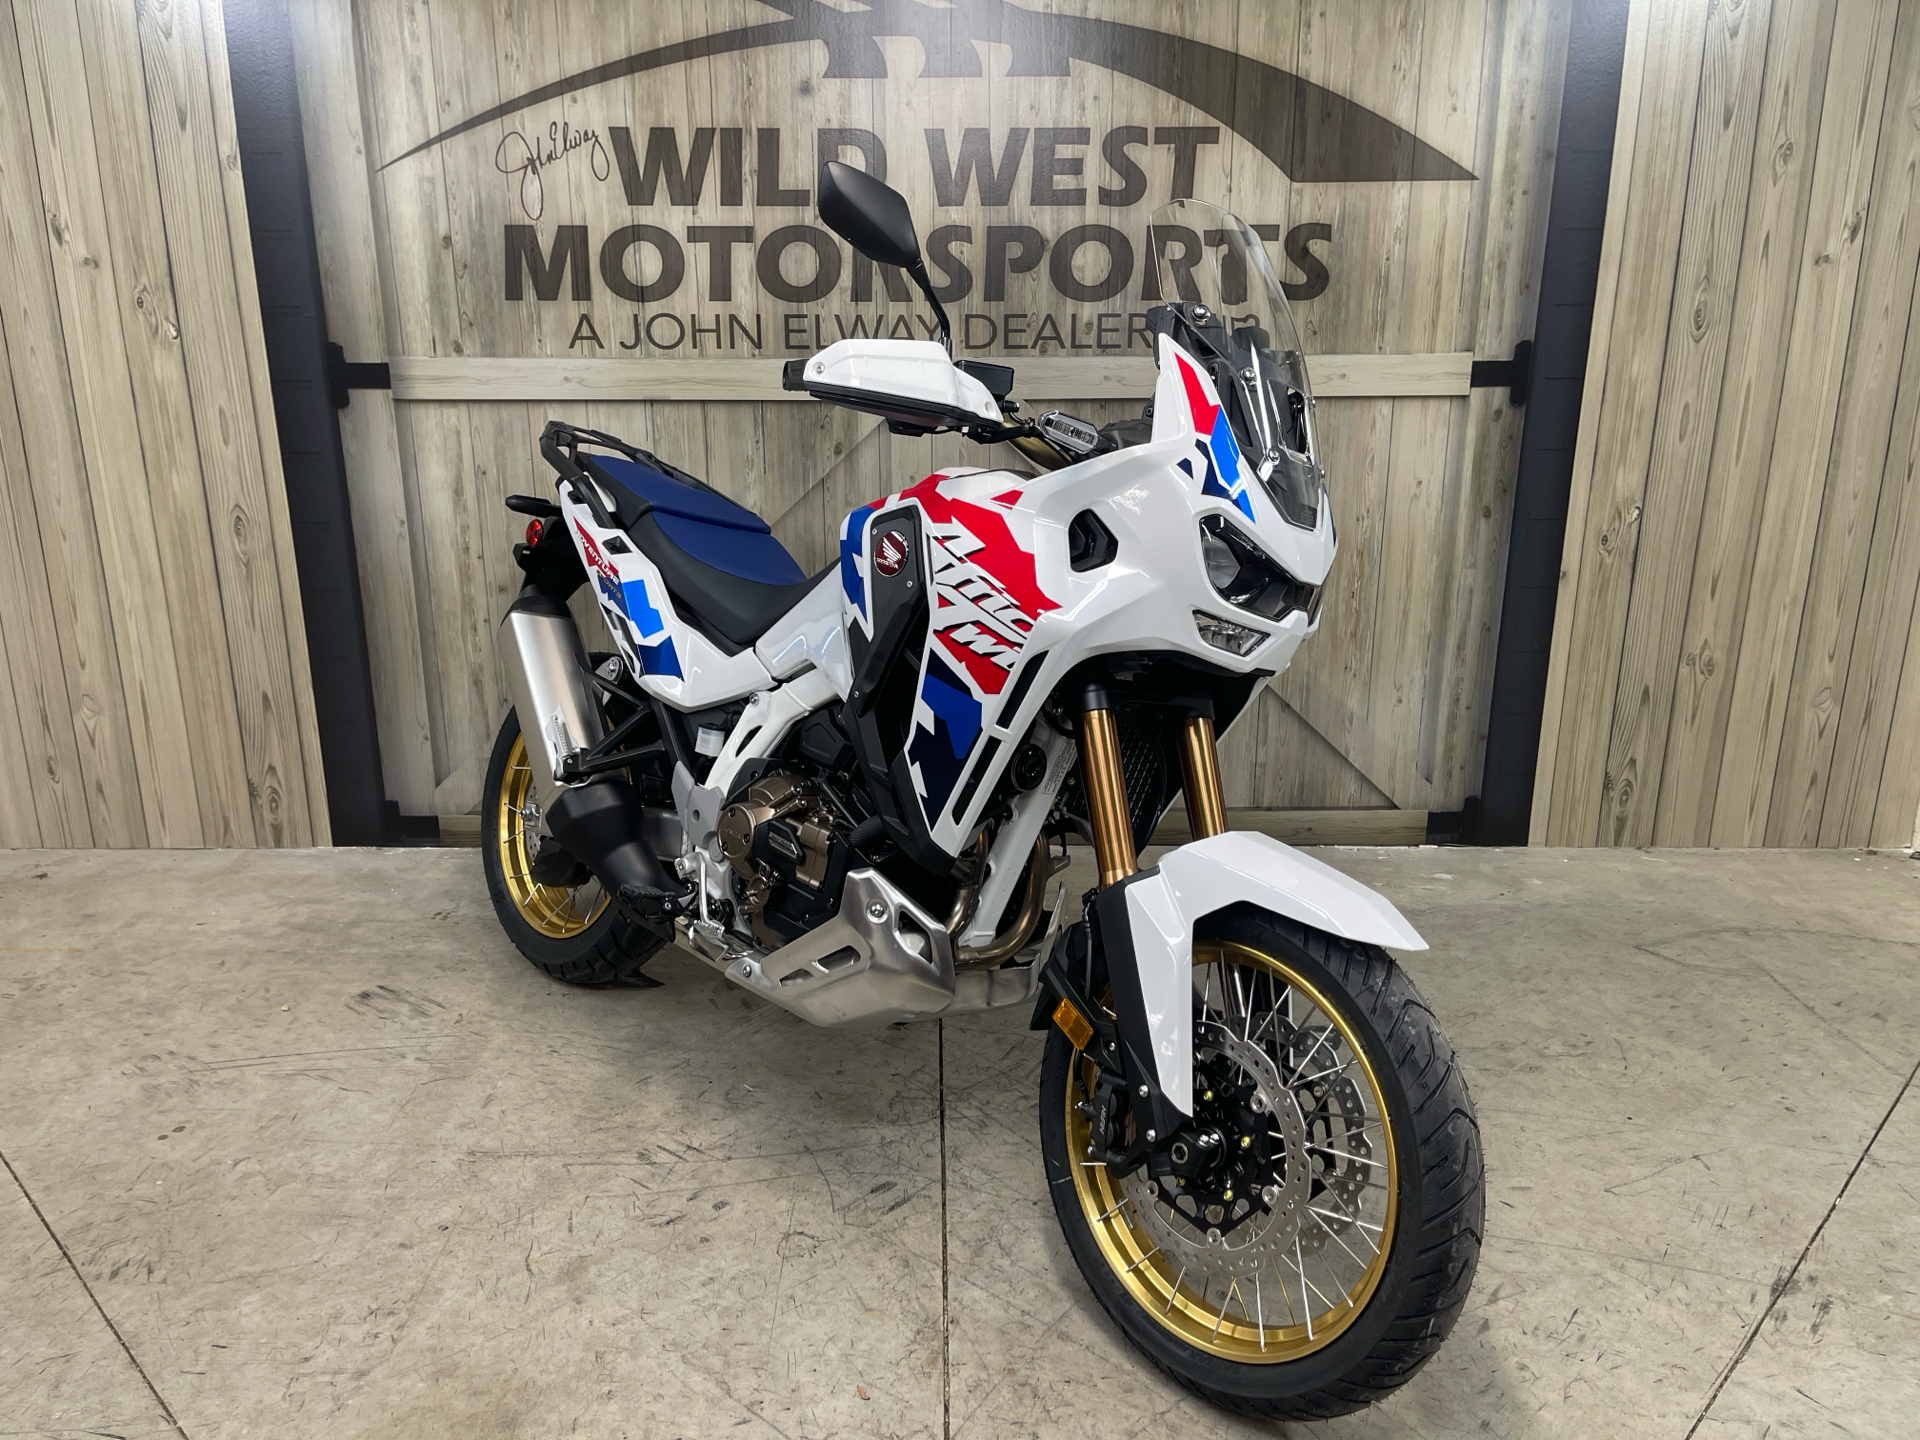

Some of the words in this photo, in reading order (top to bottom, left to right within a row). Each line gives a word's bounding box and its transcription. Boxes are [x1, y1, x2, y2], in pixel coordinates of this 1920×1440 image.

[924, 126, 1219, 208] WEST
[569, 313, 605, 349] A
[619, 312, 762, 350] JOHN
[784, 314, 940, 350] ELWAY
